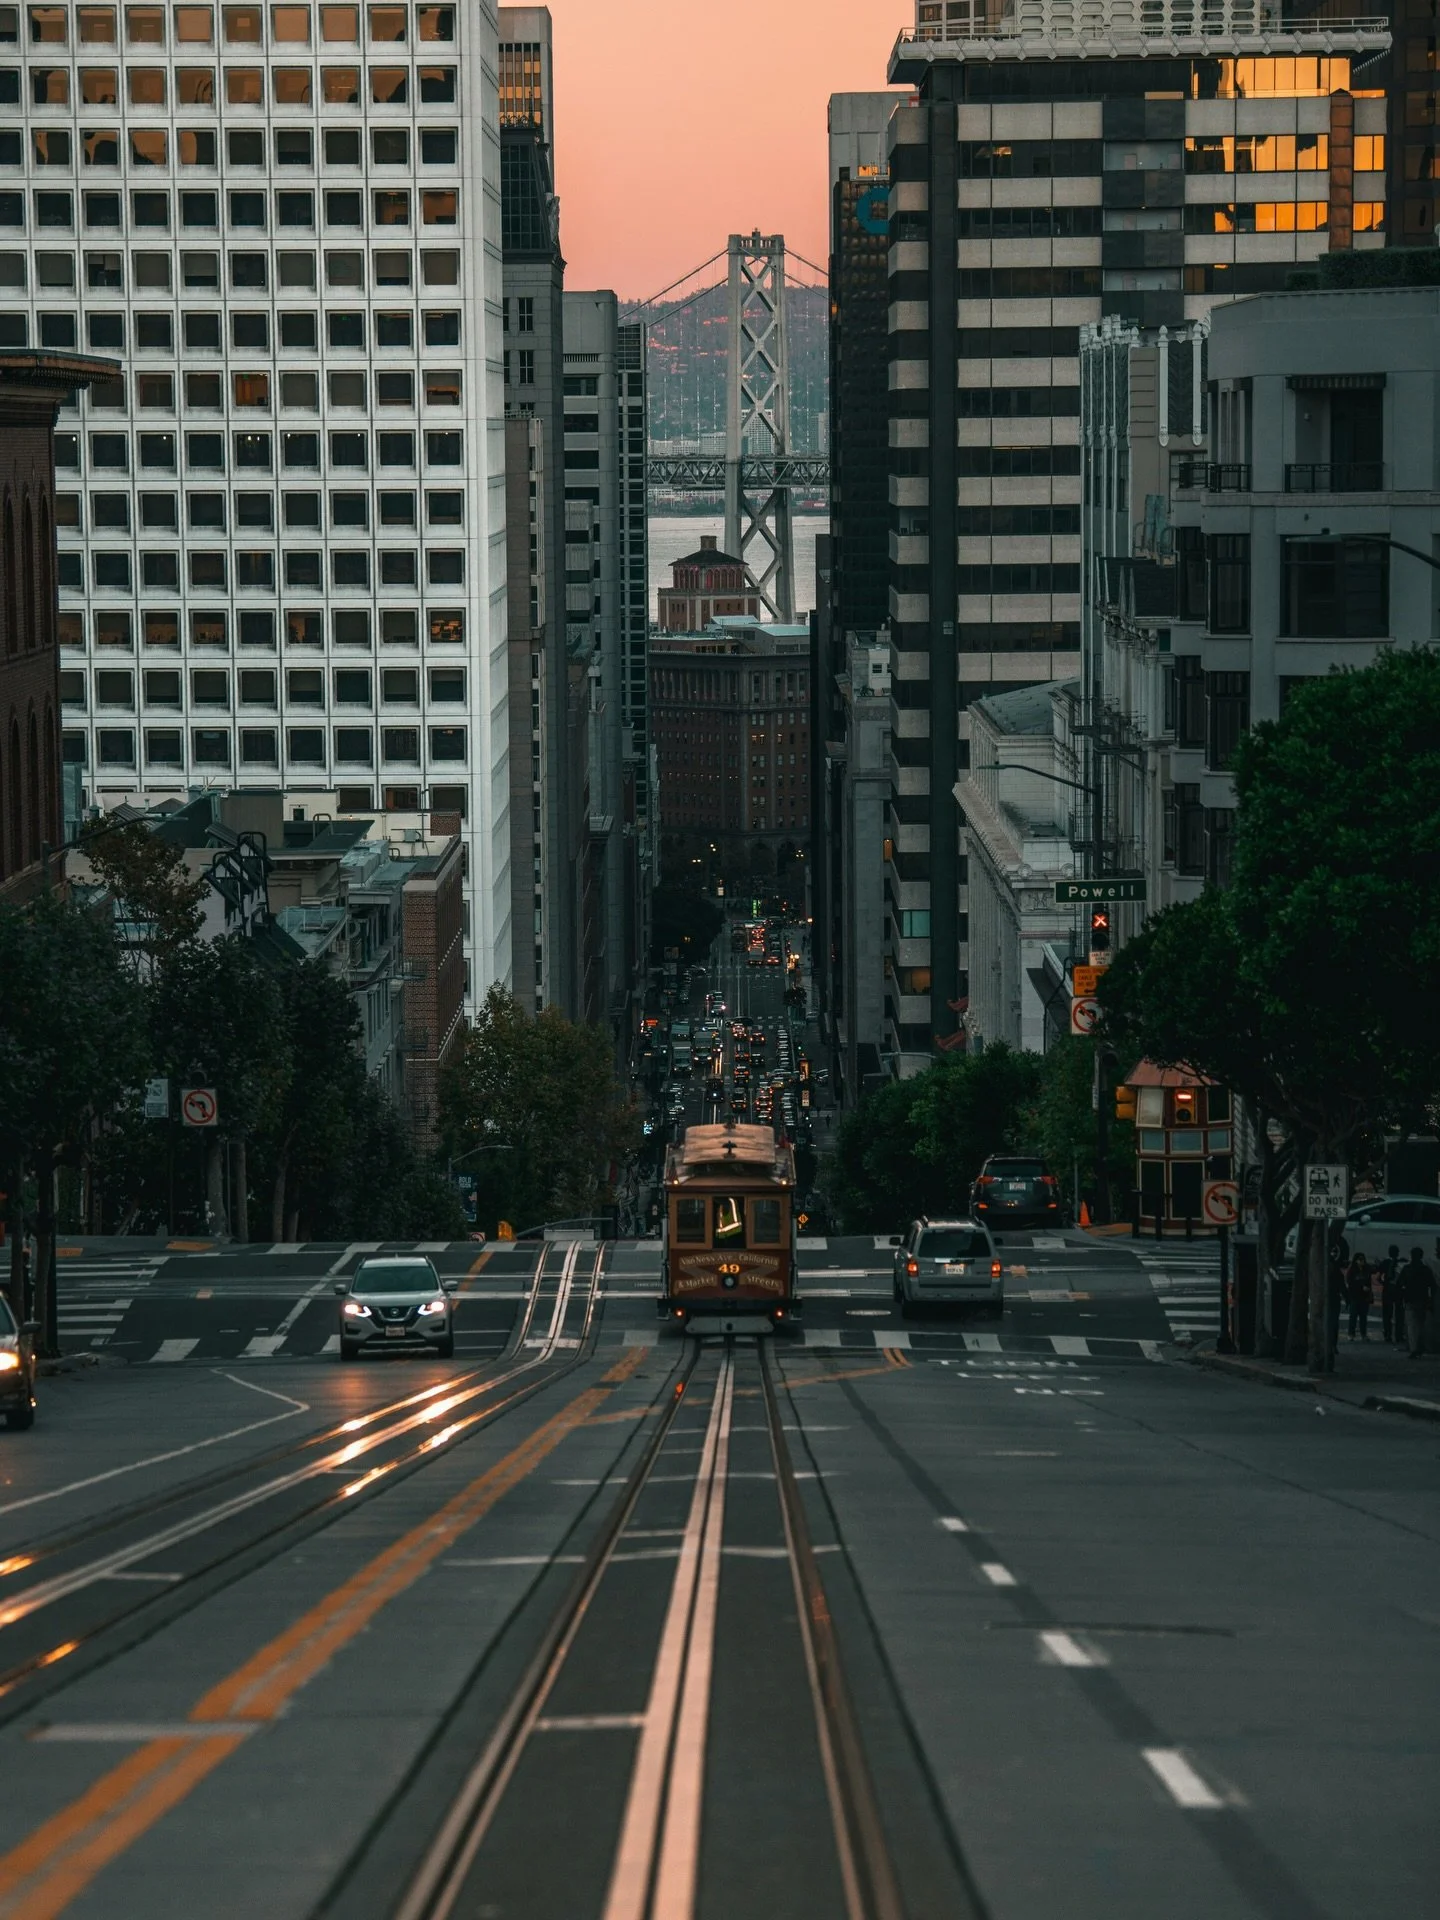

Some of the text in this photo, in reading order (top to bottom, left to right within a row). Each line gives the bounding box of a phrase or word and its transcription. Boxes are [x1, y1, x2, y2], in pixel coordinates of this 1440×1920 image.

[1068, 885, 1134, 897] Powell
[1309, 1197, 1344, 1205] DO NOT
[1314, 1207, 1338, 1216] PASS
[695, 1255, 715, 1264] Ness
[739, 1253, 779, 1266] California
[719, 1264, 739, 1273] 49
[686, 1276, 714, 1288] Market
[747, 1275, 780, 1288] Streets
[927, 1359, 1079, 1368] TURN
[957, 1372, 1101, 1381] LEFT
